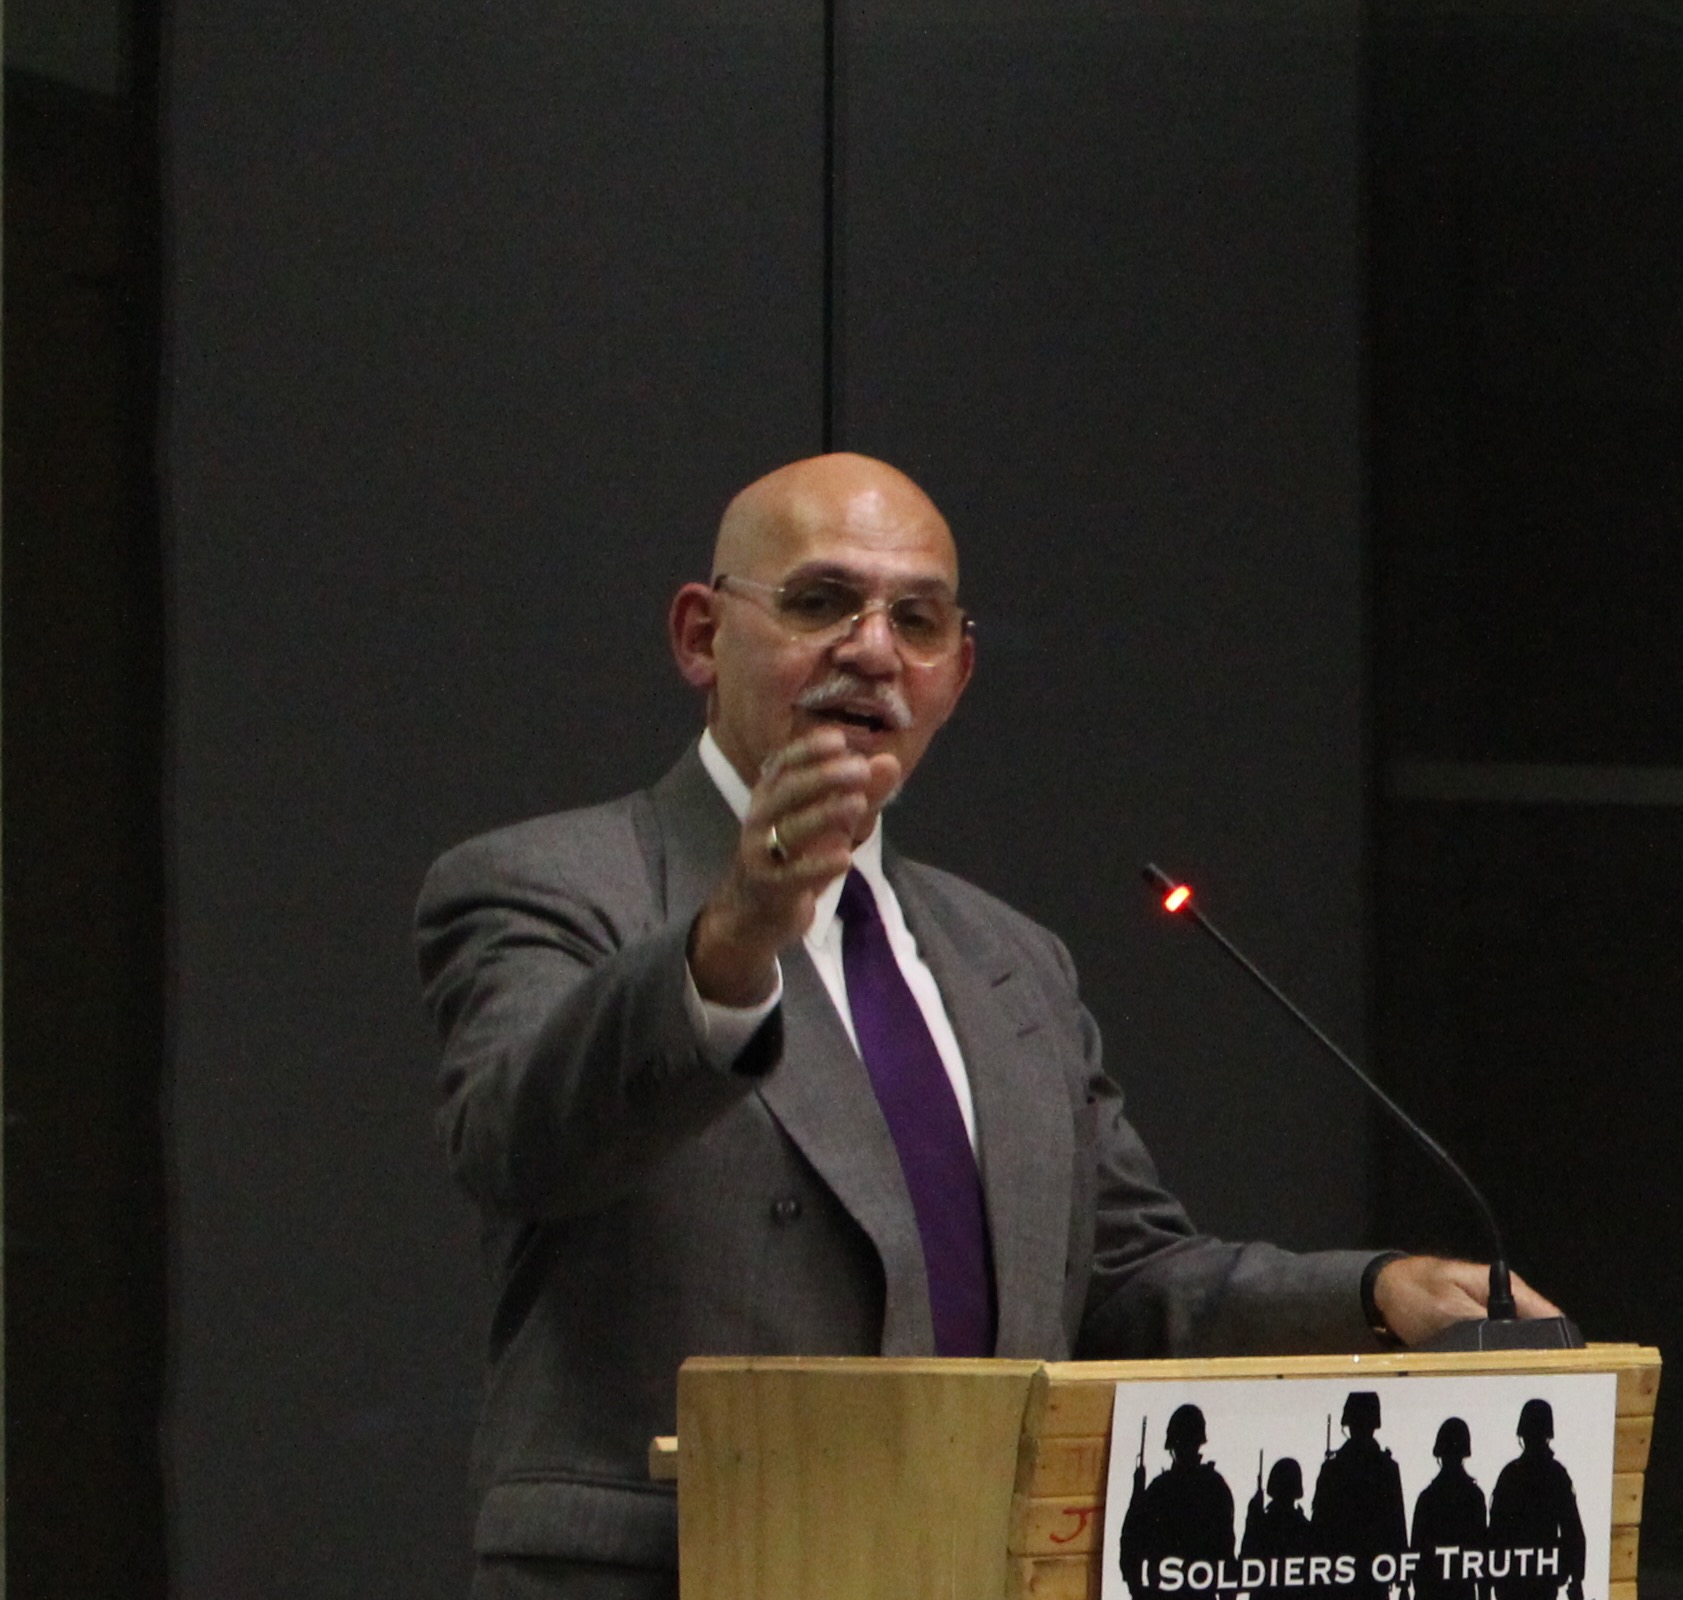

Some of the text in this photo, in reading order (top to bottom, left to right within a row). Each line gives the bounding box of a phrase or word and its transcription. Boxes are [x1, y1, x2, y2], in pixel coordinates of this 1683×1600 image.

[1158, 1546, 1560, 1591] SOLDIERS OF TRUTH
